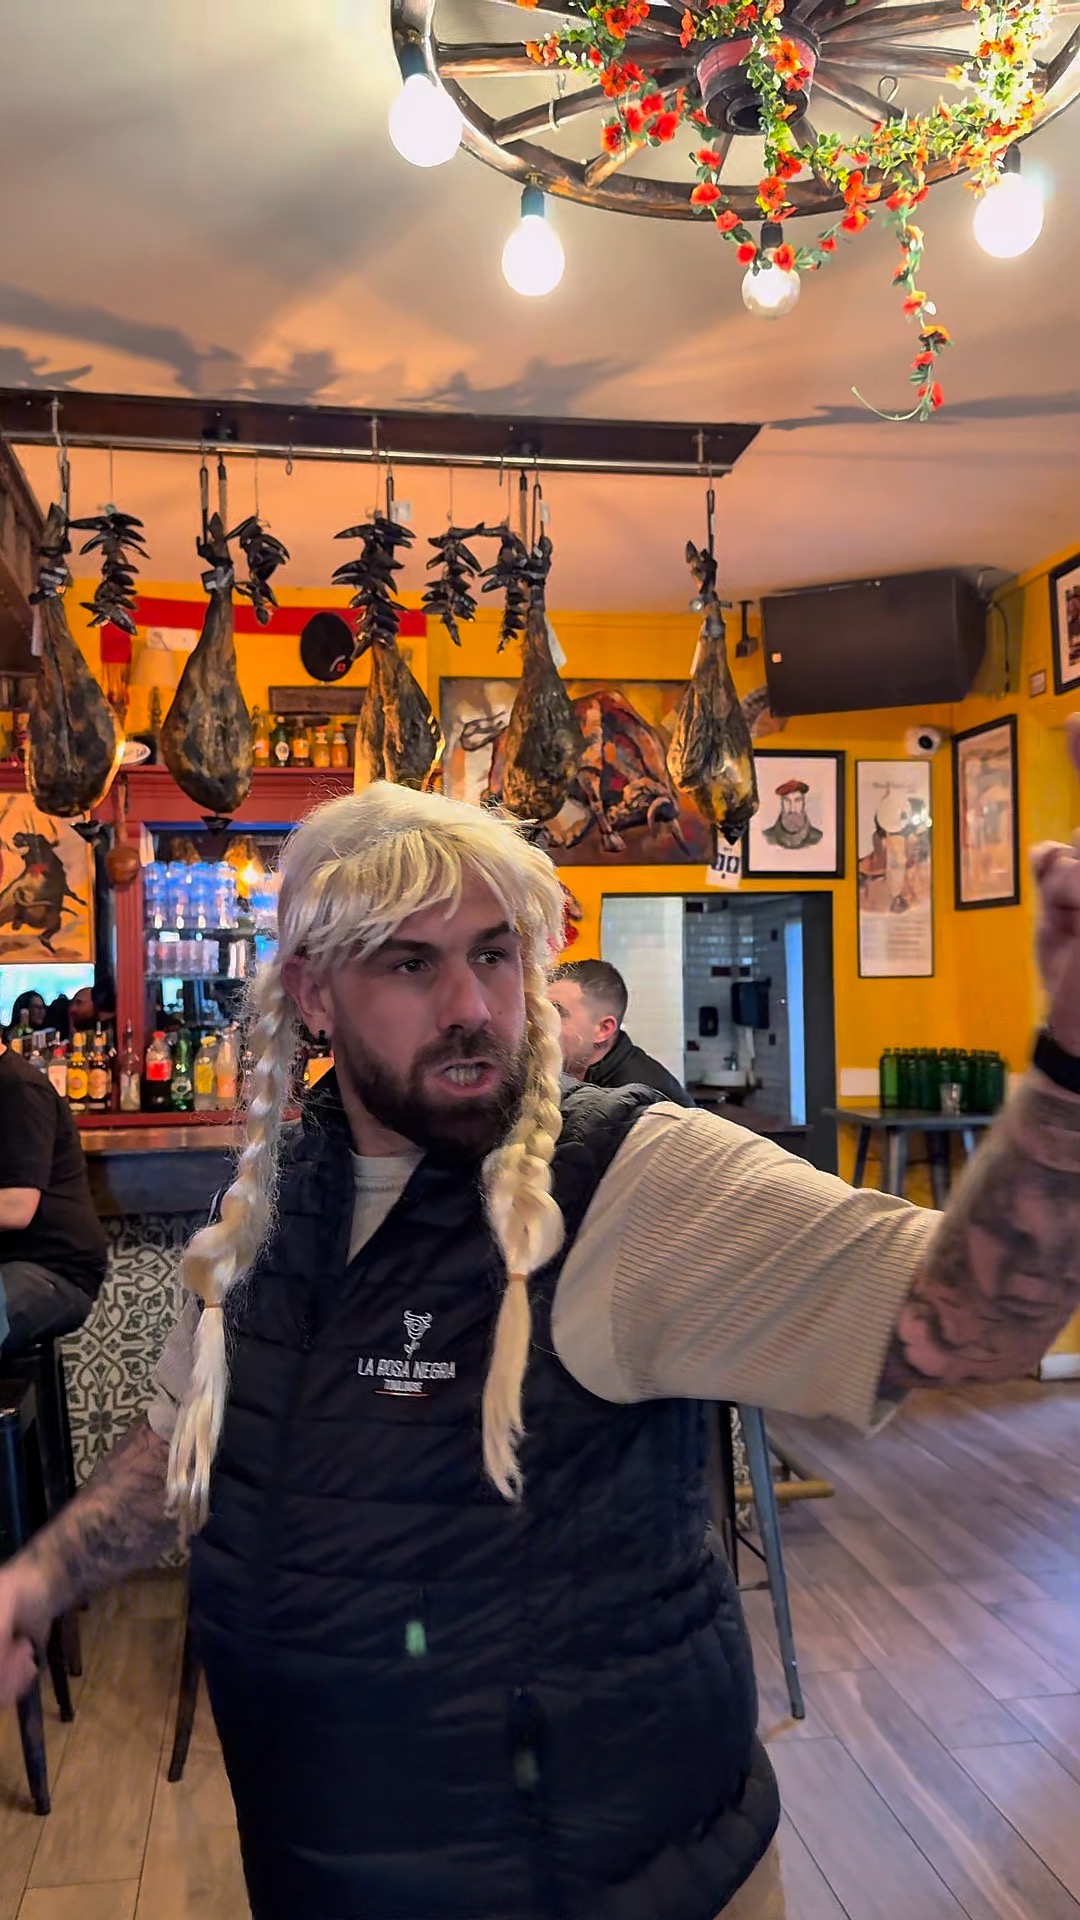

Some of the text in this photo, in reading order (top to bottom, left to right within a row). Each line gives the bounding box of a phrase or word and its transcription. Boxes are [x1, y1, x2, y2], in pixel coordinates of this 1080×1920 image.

[358, 1357, 456, 1379] LA ROSA NEGRA
